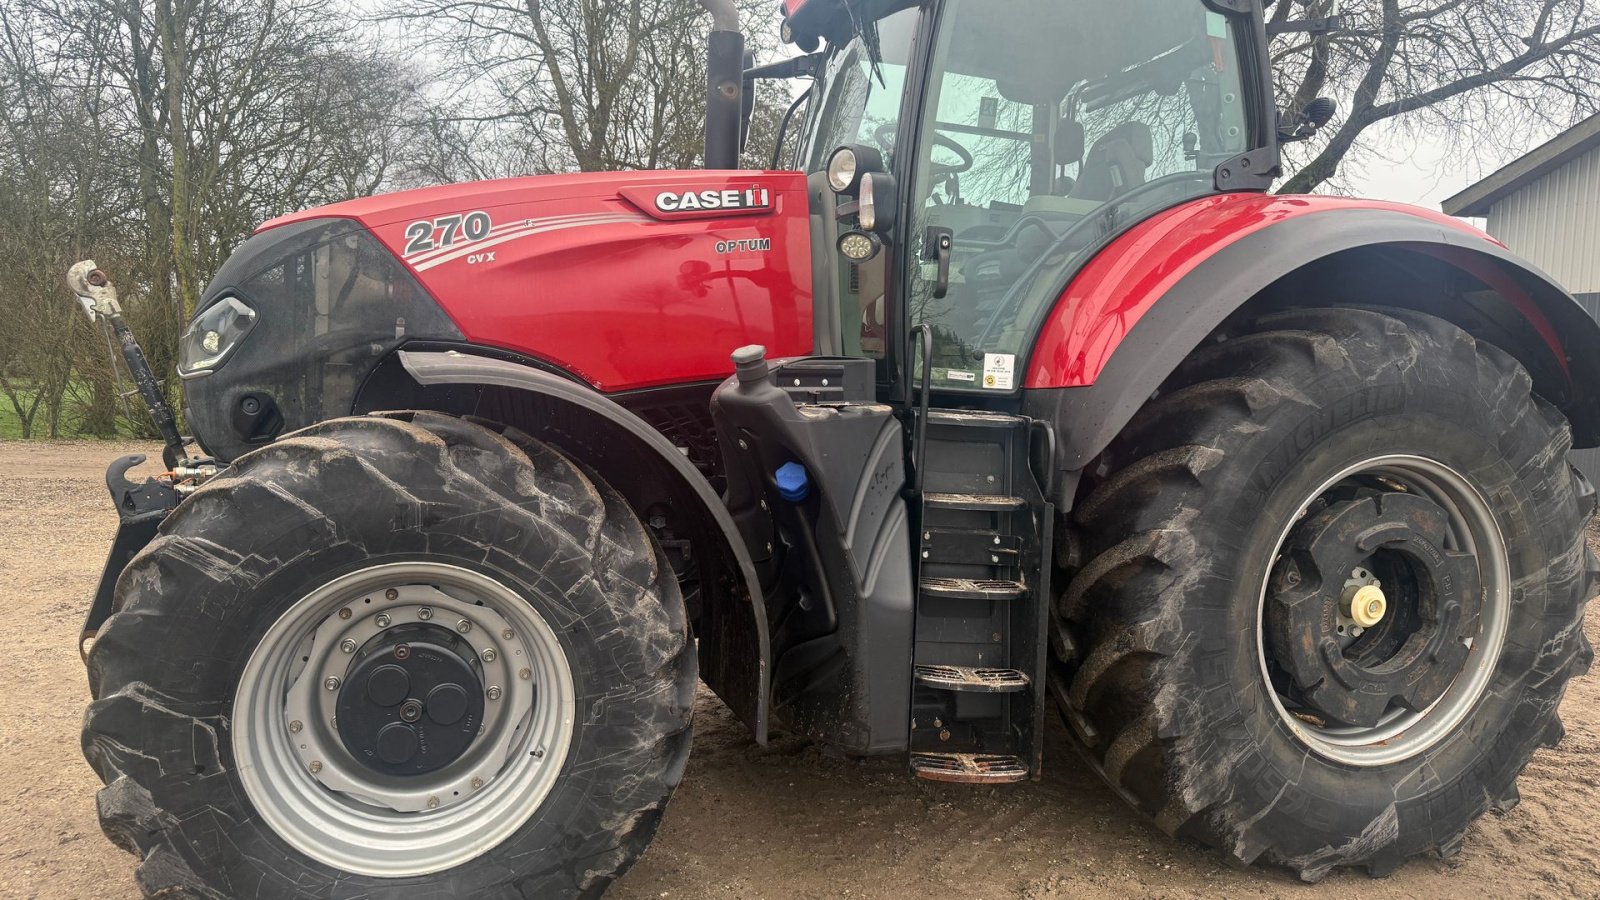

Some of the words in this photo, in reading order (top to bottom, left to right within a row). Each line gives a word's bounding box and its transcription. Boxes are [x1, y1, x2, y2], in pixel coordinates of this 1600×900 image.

[656, 189, 740, 211] CASE
[404, 210, 492, 257] 270
[715, 238, 771, 254] OPTUM
